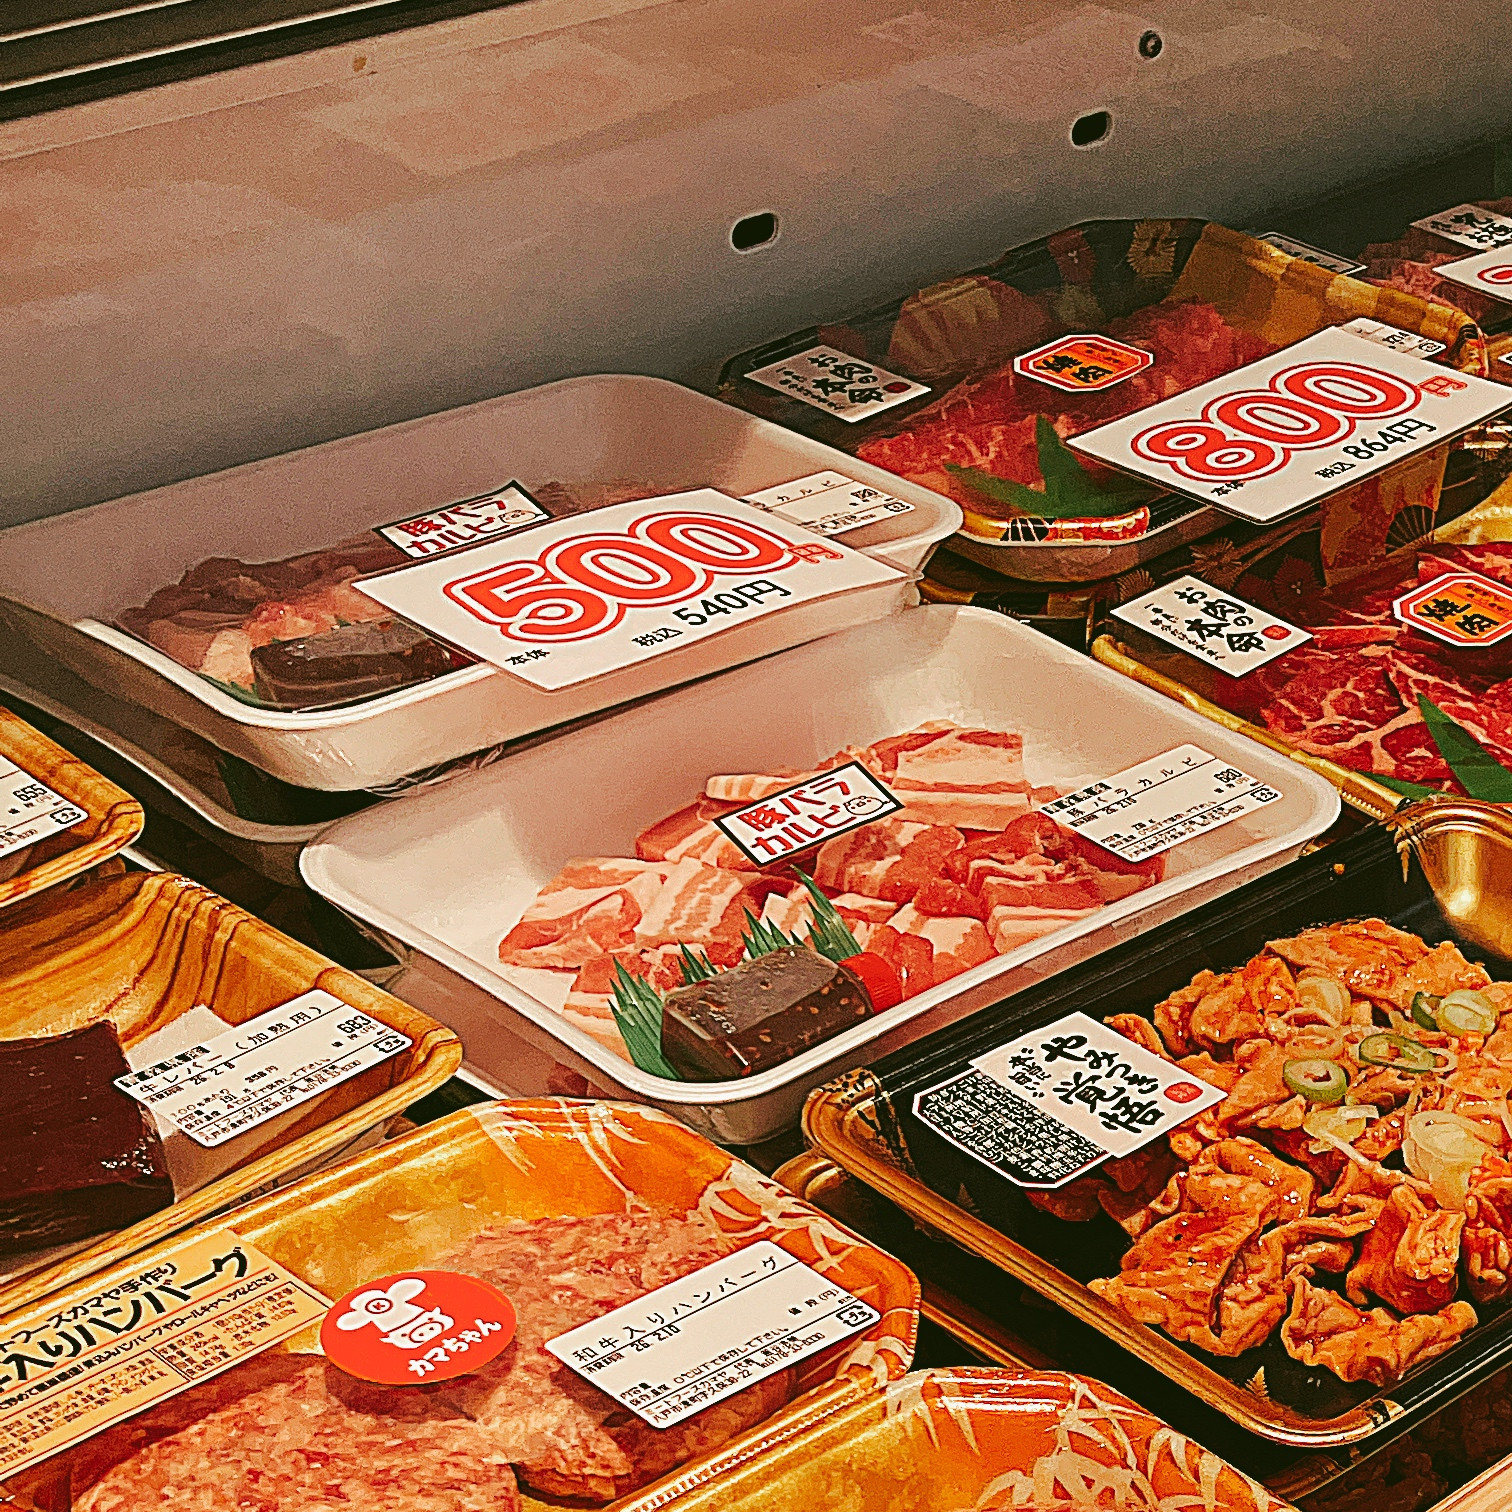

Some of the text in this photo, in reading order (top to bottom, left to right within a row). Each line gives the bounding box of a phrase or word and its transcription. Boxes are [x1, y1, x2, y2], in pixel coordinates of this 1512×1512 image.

[1315, 418, 1436, 480] 税込 864円
[401, 497, 507, 537] 豚バラ
[405, 519, 503, 556] カルビ
[633, 580, 792, 649] 税込 540円
[1418, 599, 1500, 636] 焼肉
[505, 649, 551, 666] 本体
[13, 784, 48, 802] 655
[738, 776, 851, 831] 豚バラ
[1065, 757, 1201, 817] 豚バラカルビ
[751, 807, 854, 856] カルビ
[335, 1015, 371, 1033] 683
[1042, 1035, 1160, 1093] やみつき
[570, 1254, 785, 1364] 和牛入りハンバーグ
[407, 1318, 503, 1377] カマちゃん
